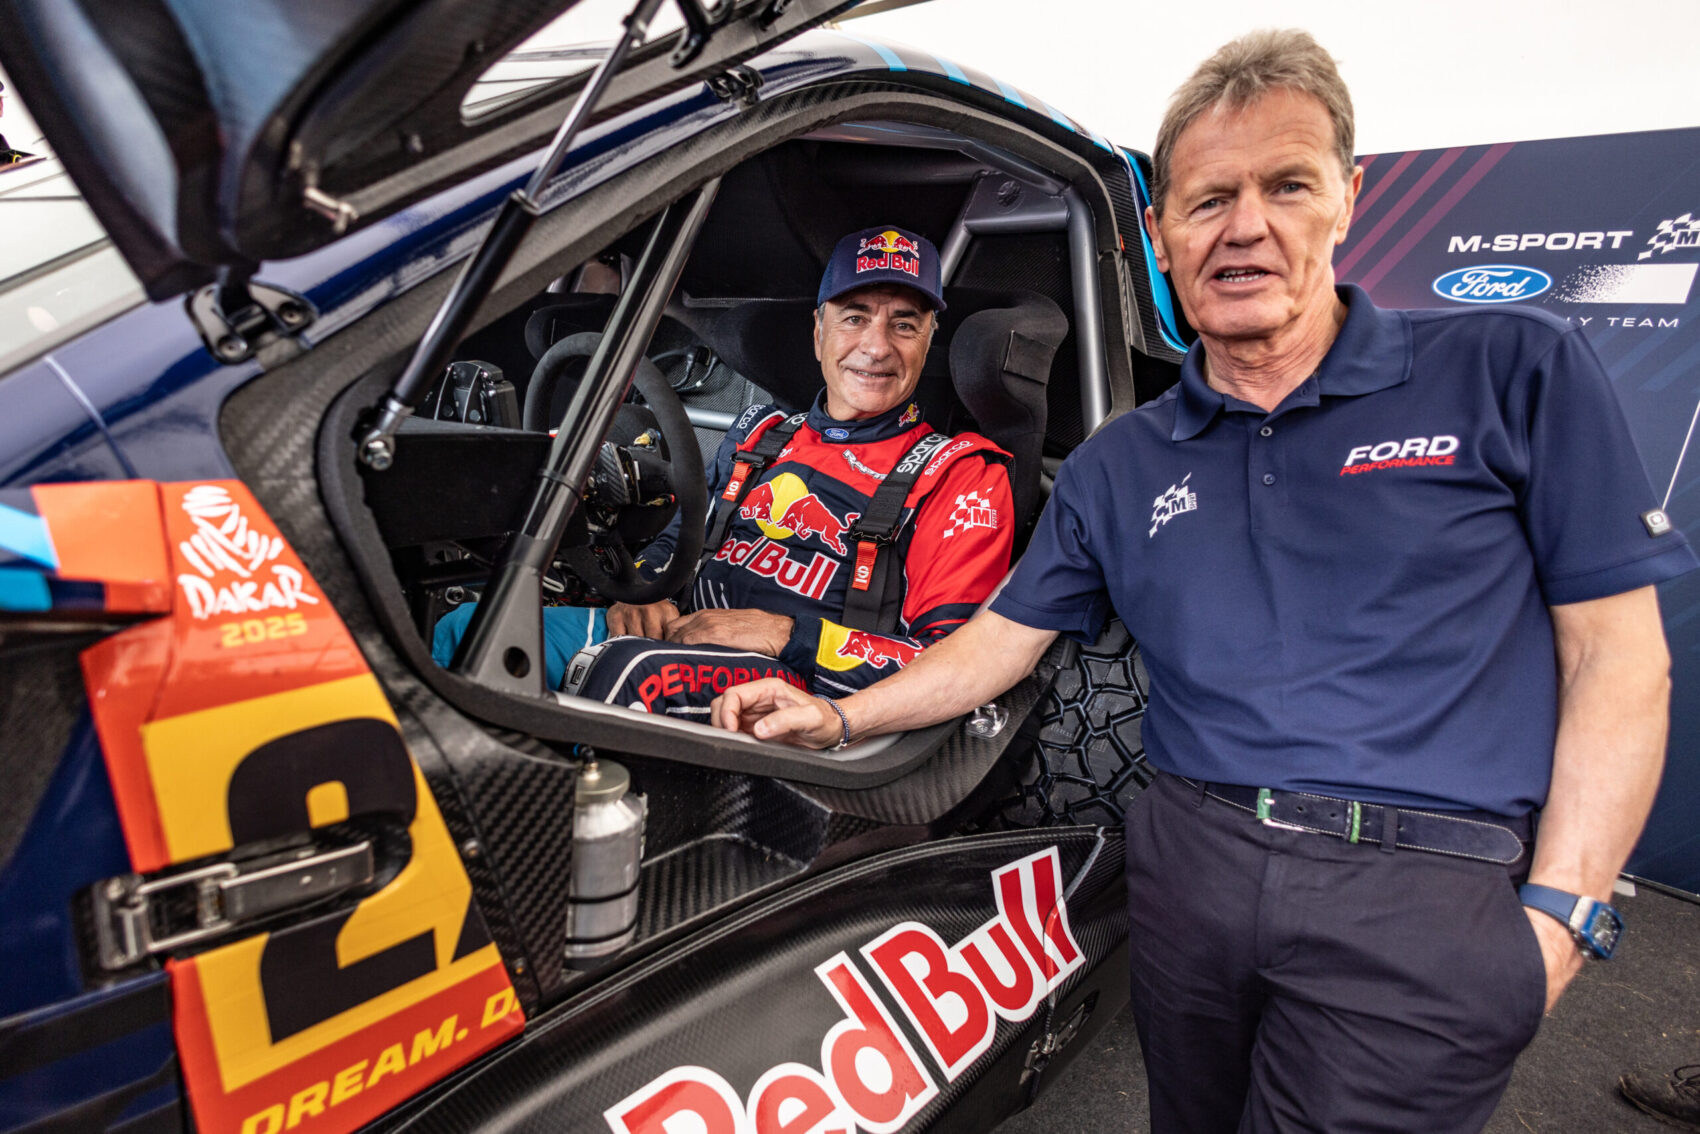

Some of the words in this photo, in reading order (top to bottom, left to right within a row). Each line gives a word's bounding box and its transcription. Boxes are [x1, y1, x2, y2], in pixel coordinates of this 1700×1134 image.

[1448, 231, 1633, 252] M-SPORT
[856, 252, 889, 273] Red
[891, 253, 919, 277] Bull
[1447, 267, 1537, 299] Ford
[1607, 317, 1680, 328] TEAM
[1340, 455, 1456, 476] PERFORMANCE
[1344, 435, 1460, 466] FORD
[713, 536, 767, 566] ed
[745, 540, 841, 600] Bull
[177, 564, 320, 620] DAKAR
[220, 612, 308, 648] 2025
[859, 845, 1087, 1084] Bull
[240, 1013, 469, 1134] DREAM.
[480, 986, 521, 1029] D
